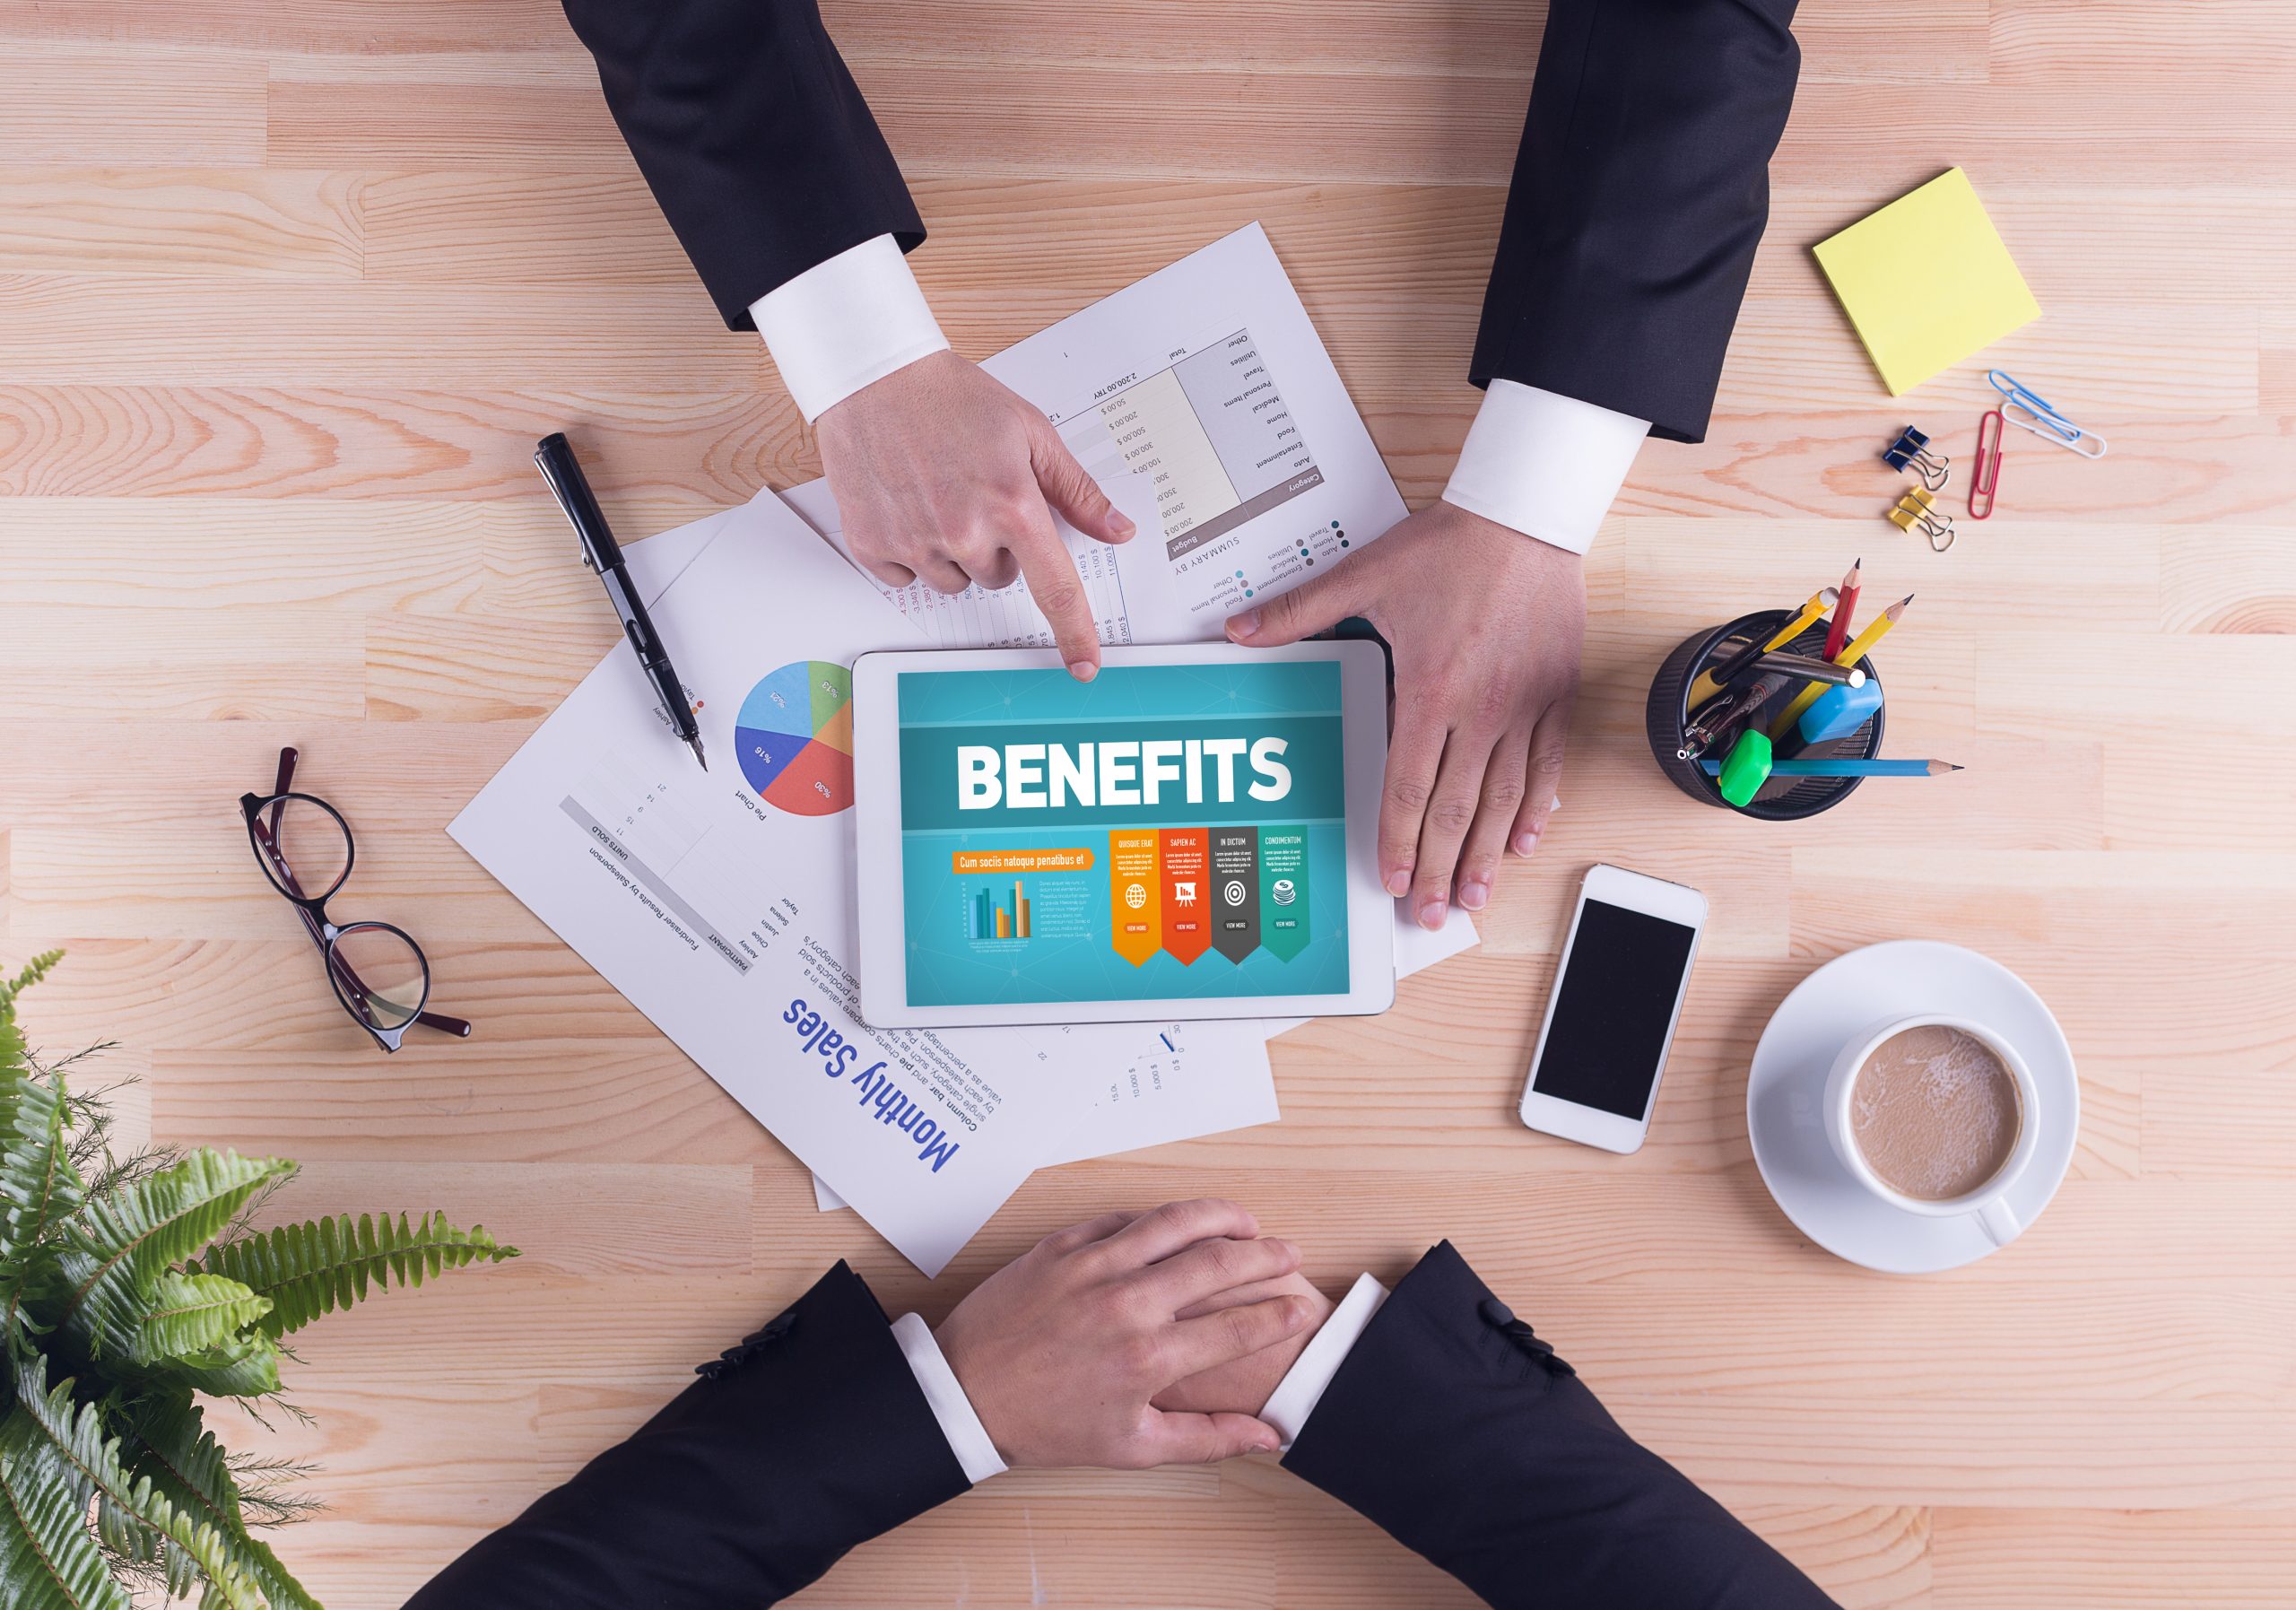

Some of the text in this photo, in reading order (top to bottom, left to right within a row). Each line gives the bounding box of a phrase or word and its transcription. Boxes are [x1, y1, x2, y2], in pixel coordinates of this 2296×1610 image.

[1228, 335, 1248, 348] Other
[1169, 347, 1187, 361] Total
[1230, 351, 1257, 366] Utilities
[1243, 366, 1265, 380] Travel
[1093, 372, 1137, 400] 2.200,00 TRY
[1223, 380, 1272, 407] Personal Items
[1107, 398, 1126, 413] 50,00
[1252, 396, 1280, 413] Medical
[1114, 411, 1138, 428] 200,00
[1266, 411, 1288, 424] Home
[1122, 426, 1146, 442] 500,00
[1277, 426, 1296, 439] Food
[1130, 441, 1153, 457] 300,00
[1256, 441, 1303, 468] Entertainment
[1138, 457, 1161, 473] 100,00
[1293, 456, 1309, 467] Auto
[1289, 474, 1319, 492] Category
[1161, 502, 1186, 518] 200,00
[1170, 518, 1193, 534] 200,00
[1309, 527, 1329, 542] Travel
[1172, 535, 1198, 553] Budget
[1313, 535, 1335, 549] Home
[1322, 545, 1338, 557] Auto
[1175, 536, 1239, 576] SUMMARY BY
[1267, 545, 1293, 561] Utilities
[1080, 561, 1089, 580] 9.140
[1091, 555, 1102, 579] 10.100
[1105, 553, 1117, 577] 11.060
[1271, 554, 1298, 572] Medical
[1213, 576, 1233, 589] Other
[1257, 564, 1303, 591] Entertainment
[910, 590, 920, 614] -3.340
[923, 588, 934, 611] -2.380
[1191, 586, 1239, 612] Personal Items
[1224, 595, 1243, 609] Food
[652, 707, 672, 726] Ashley
[754, 746, 772, 764] %16
[957, 736, 1292, 810] BENEFITS
[657, 783, 666, 792] 21
[735, 790, 767, 821] Pie Chart
[592, 826, 629, 860] UNITS SOLD
[1265, 836, 1301, 845] CONDIMENTUM
[960, 857, 978, 868] Cum
[979, 856, 1002, 867] sociis
[1004, 856, 1035, 869] natoque
[1037, 854, 1074, 869] penatibus
[589, 848, 700, 951] Fundraiser Results by Salesperson
[781, 898, 798, 916] Taylor
[770, 906, 789, 927] Selena
[761, 919, 779, 936] Justin
[752, 931, 769, 948] Chloe
[708, 934, 748, 970] PARTICIPANT
[739, 940, 759, 959] Ashley
[810, 974, 819, 986] in
[818, 982, 843, 1007] values
[841, 1005, 876, 1036] compare
[797, 948, 987, 1122] single category, such as the of products sold
[904, 1029, 918, 1045] Pie
[875, 1035, 900, 1058] charts
[924, 1027, 967, 1070] percentage
[1038, 1051, 1047, 1060] 22
[899, 1057, 915, 1071] pie
[920, 1041, 965, 1086] salesperson.
[783, 999, 961, 1173] Monthly Sales
[910, 1069, 928, 1085] and
[971, 1075, 982, 1085] as
[929, 1083, 944, 1101] bar,
[964, 1084, 984, 1103] each
[981, 1083, 1002, 1104] value
[946, 1099, 978, 1132] Column,
[982, 1101, 995, 1115] by
